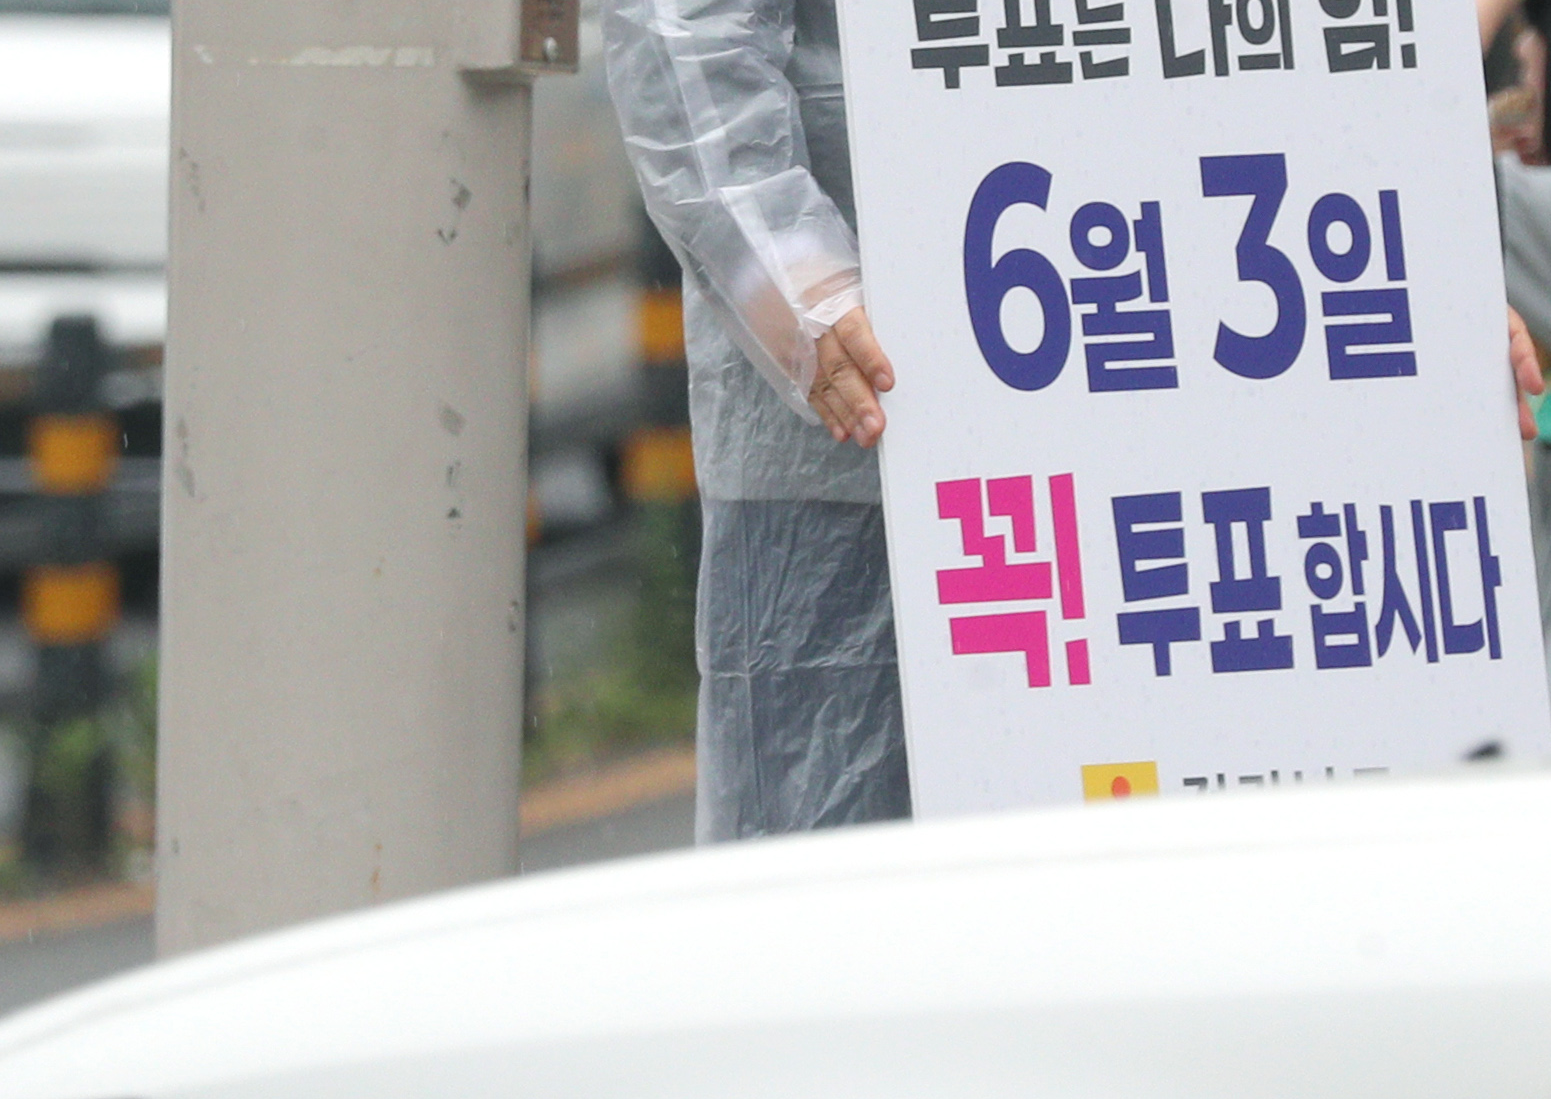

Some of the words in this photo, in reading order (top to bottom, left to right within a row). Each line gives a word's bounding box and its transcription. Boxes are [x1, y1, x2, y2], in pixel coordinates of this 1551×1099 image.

[963, 160, 1179, 393] 6월
[1199, 152, 1418, 380] 3일
[935, 472, 1092, 688] 꼭!
